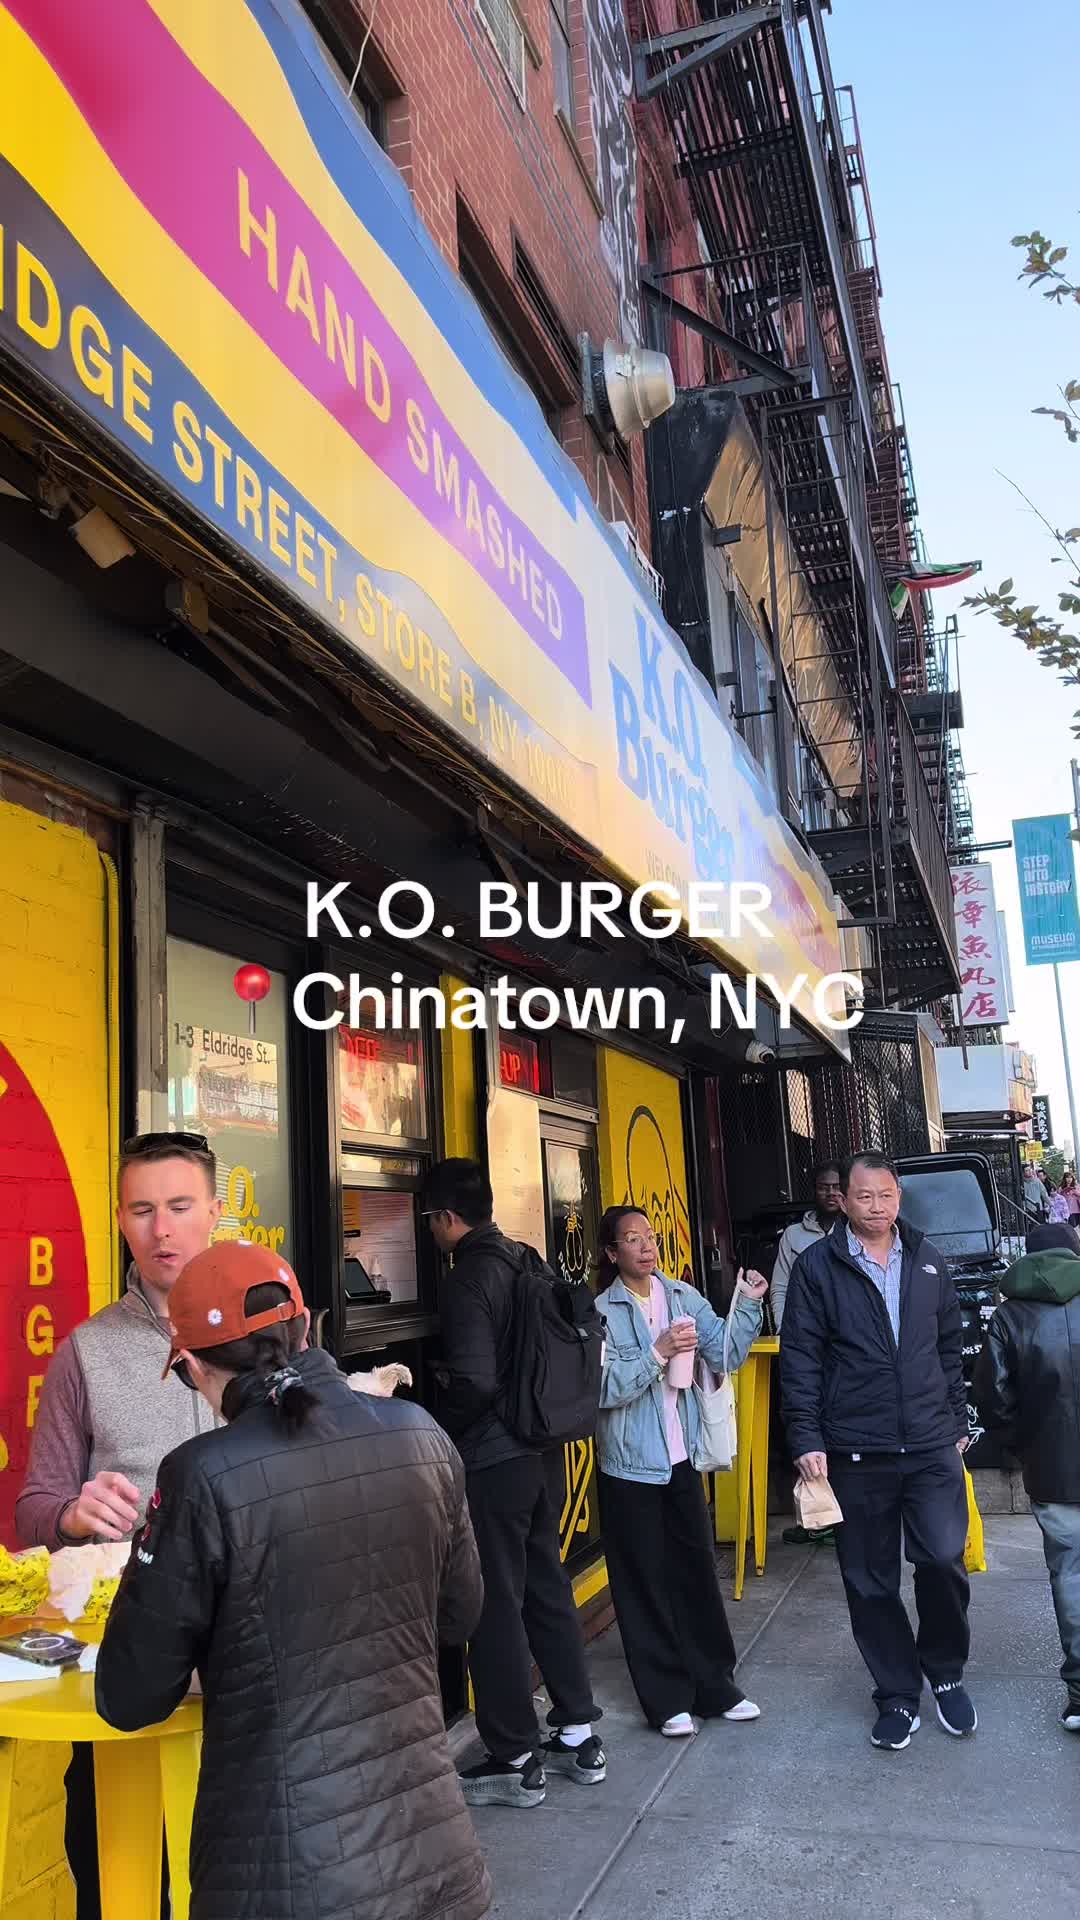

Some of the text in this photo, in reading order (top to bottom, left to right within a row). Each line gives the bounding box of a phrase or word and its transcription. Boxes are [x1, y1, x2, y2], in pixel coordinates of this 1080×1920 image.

[238, 167, 563, 641] HAND SMASHED
[0, 223, 153, 446] DGE
[173, 400, 346, 624] STREET,
[356, 572, 453, 707] STORE
[488, 696, 518, 762] NY
[633, 599, 709, 791] K.O.
[1023, 855, 1050, 869] STEP
[1024, 869, 1049, 882] INTO
[1031, 932, 1076, 945] MUSEUM
[174, 1022, 271, 1065] 1-3 Eldridge St.
